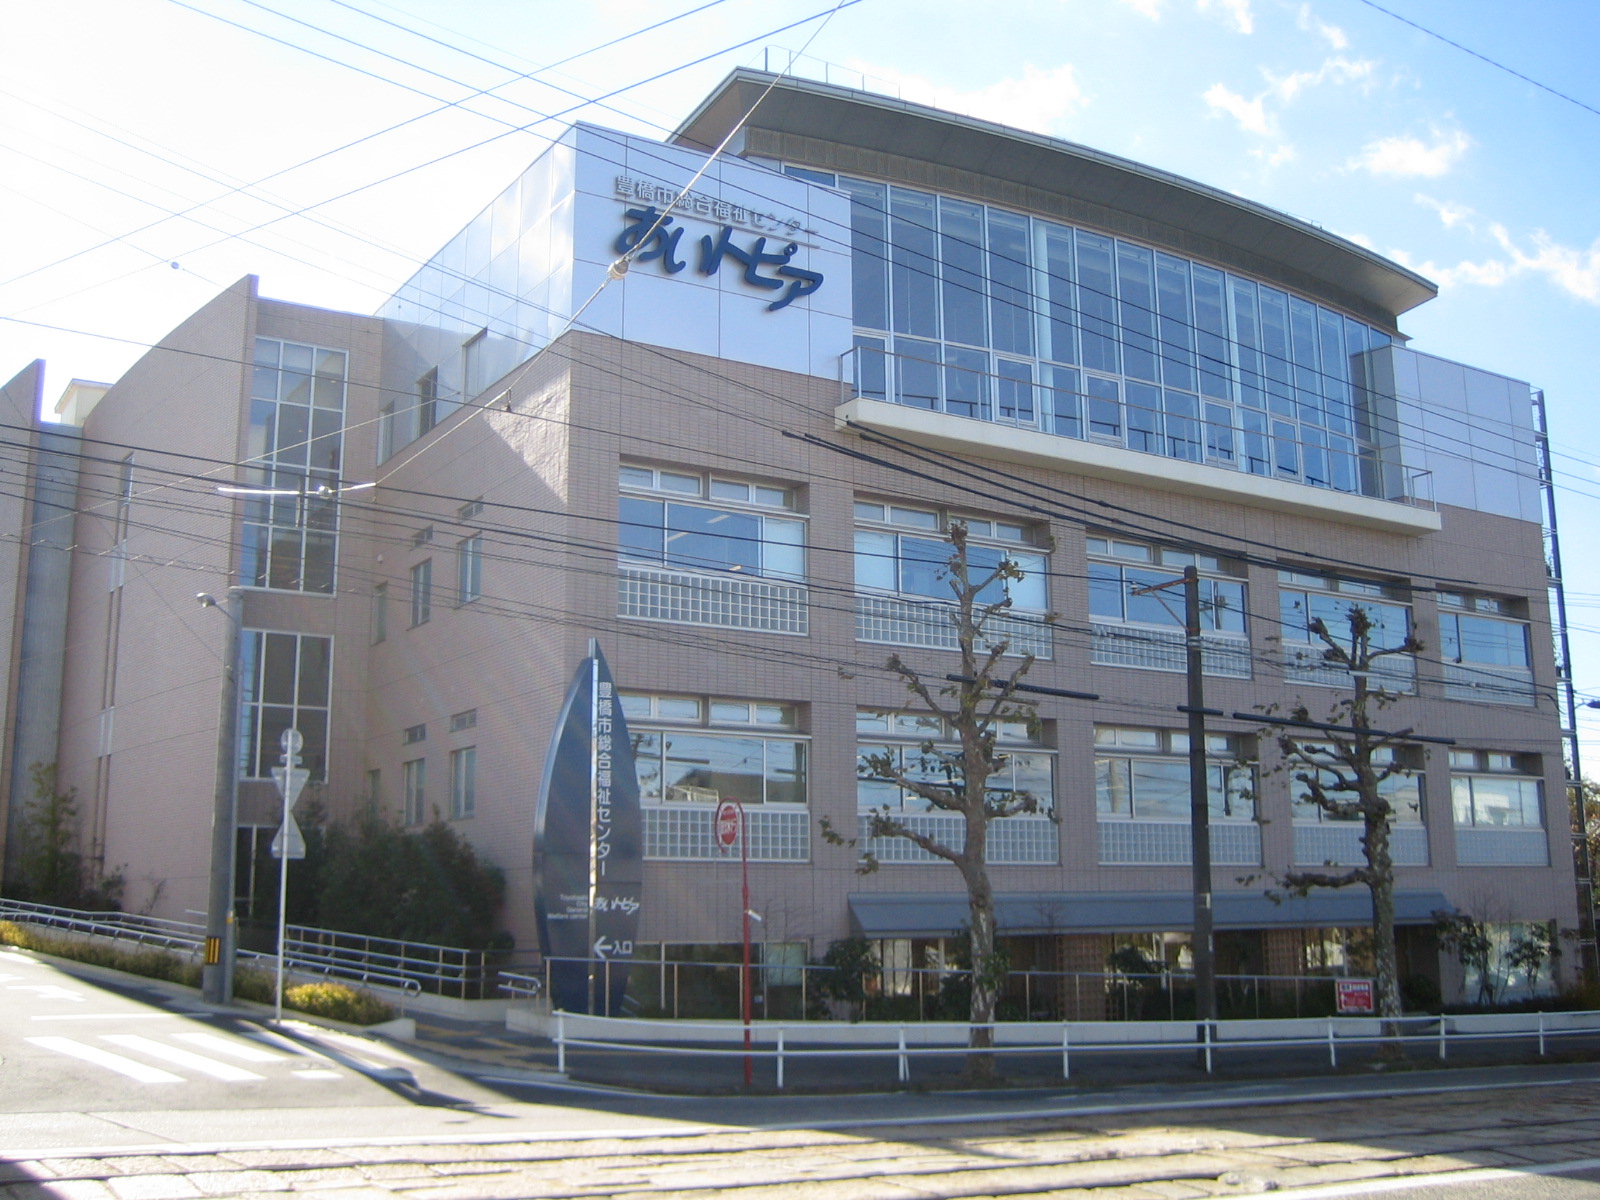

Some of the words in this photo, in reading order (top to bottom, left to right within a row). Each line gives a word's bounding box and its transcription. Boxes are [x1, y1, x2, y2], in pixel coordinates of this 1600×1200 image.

[614, 206, 824, 311] あいトピア
[598, 681, 612, 876] 豊橋市総合福祉センター
[612, 940, 633, 954] 入口
